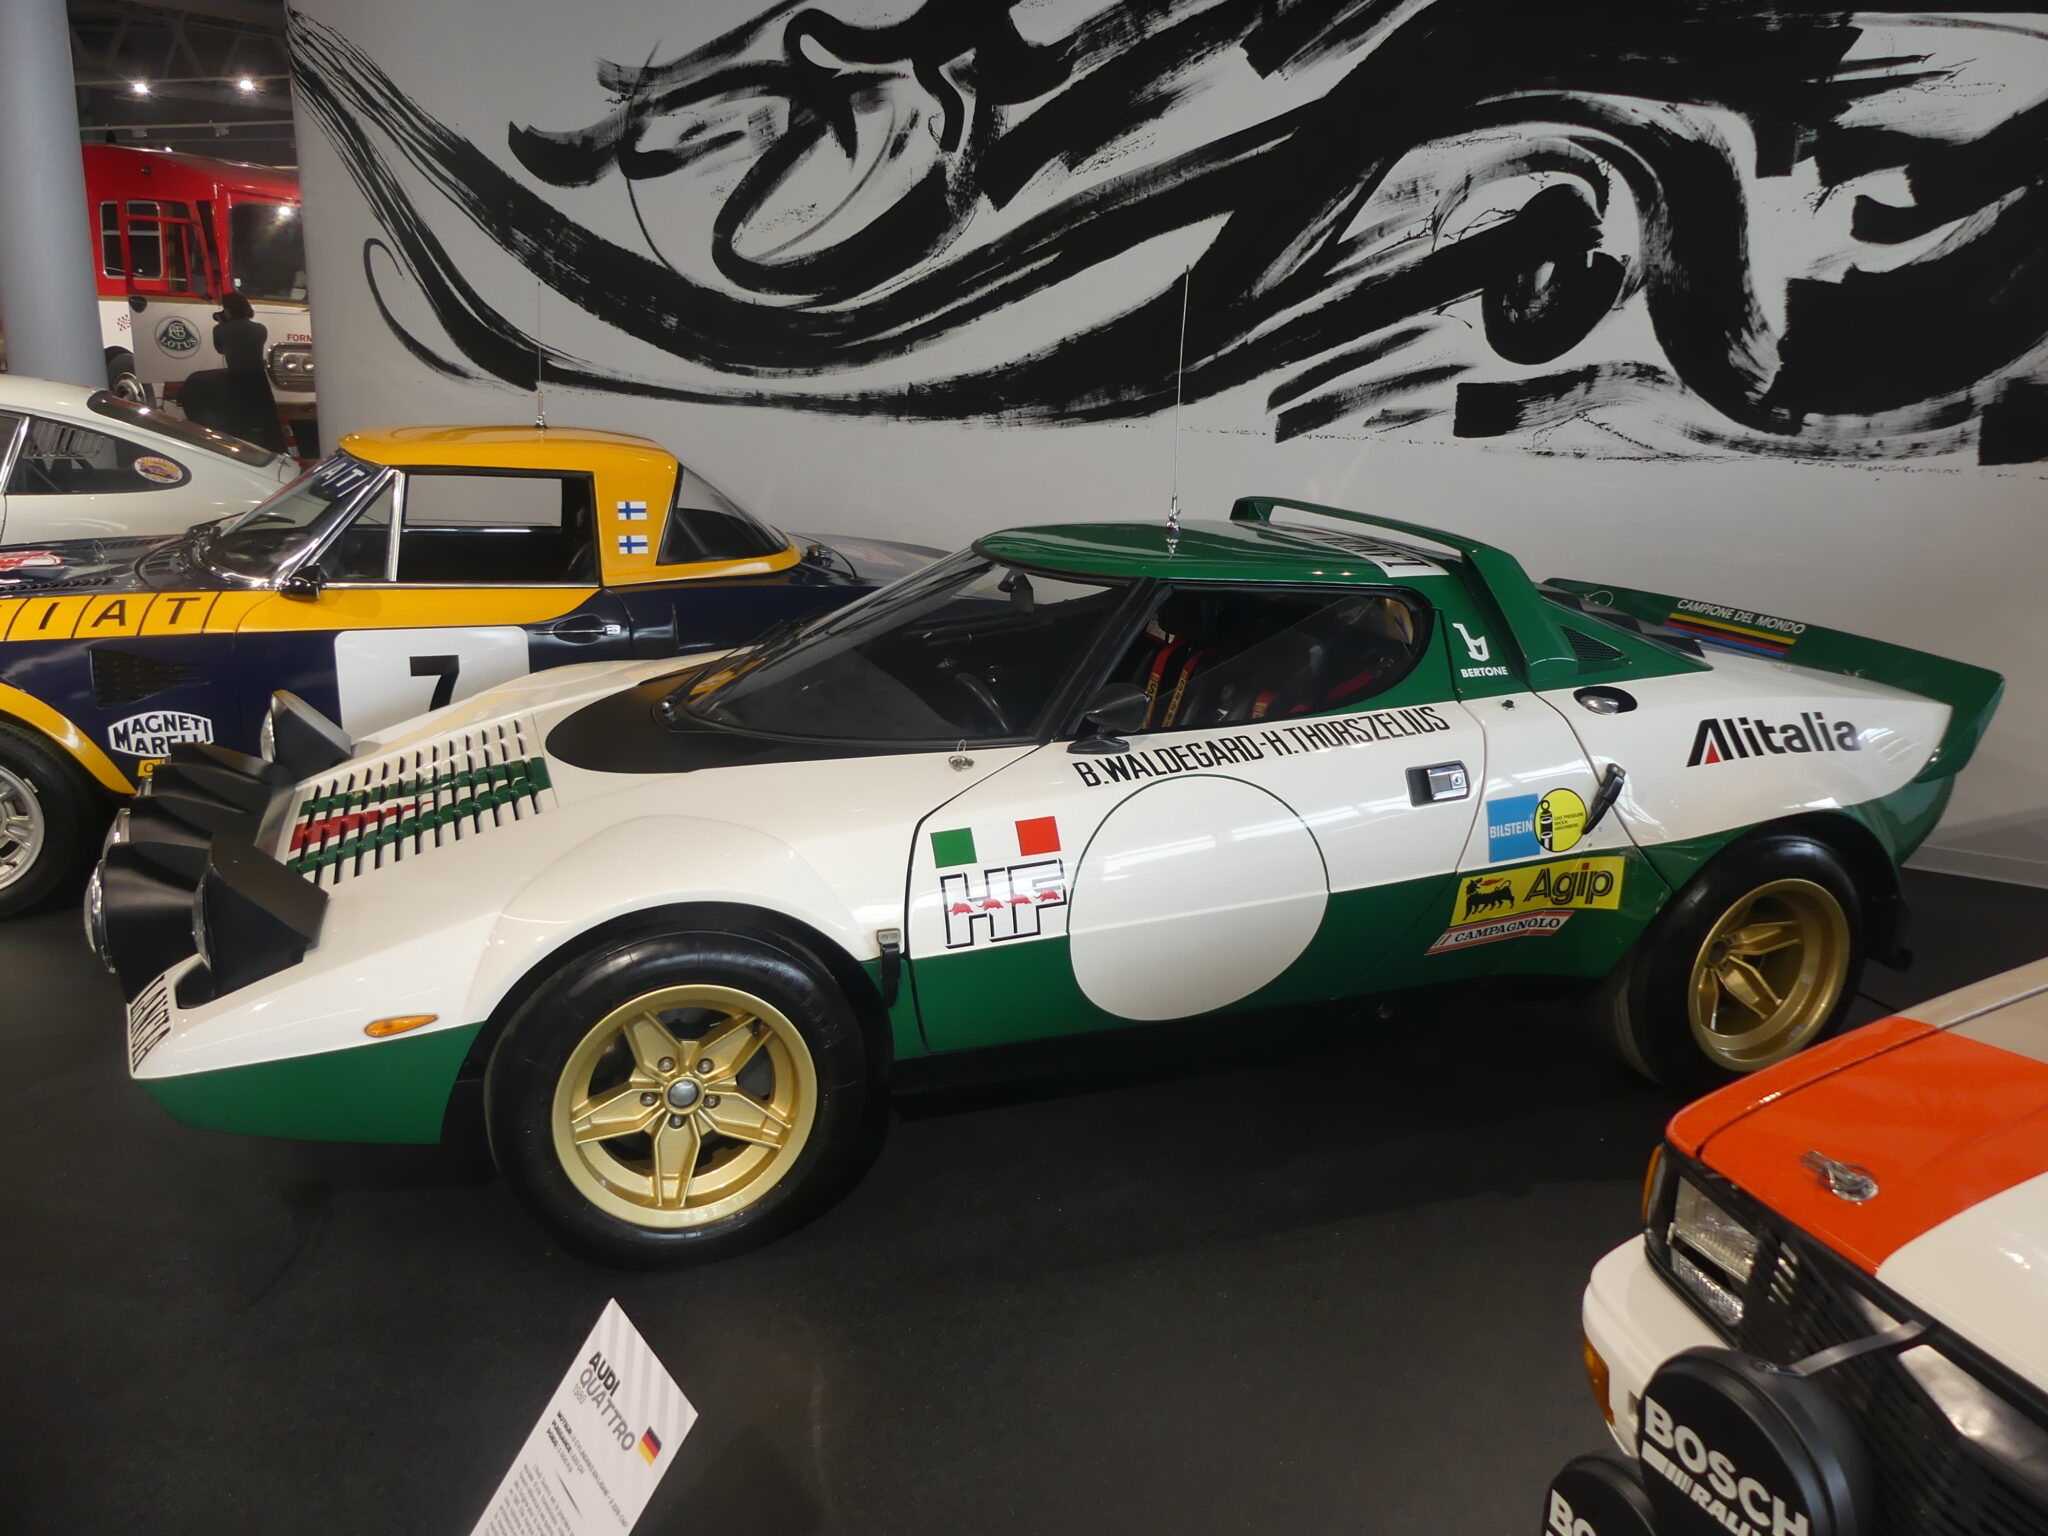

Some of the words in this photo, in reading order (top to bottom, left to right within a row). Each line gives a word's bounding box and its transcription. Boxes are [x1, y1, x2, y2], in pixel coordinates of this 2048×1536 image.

[161, 336, 197, 349] LOTUS
[0, 597, 201, 630] IAT
[1677, 599, 1734, 619] CAMPIONE
[1733, 610, 1756, 624] DEL
[1754, 615, 1806, 634] MONDO
[410, 655, 460, 712] 7
[1460, 666, 1509, 678] BERTONE
[113, 714, 211, 748] MAGNETI
[1686, 711, 1861, 768] Alitalia
[1490, 821, 1533, 839] BILSTEIN
[939, 857, 1067, 949] HF
[1523, 862, 1614, 905] Agip
[1454, 917, 1561, 943] CAMPAGNOLO
[589, 1351, 620, 1396] AUDI
[579, 1367, 636, 1452] QUATTRO
[1644, 1395, 1809, 1536] BOSCH
